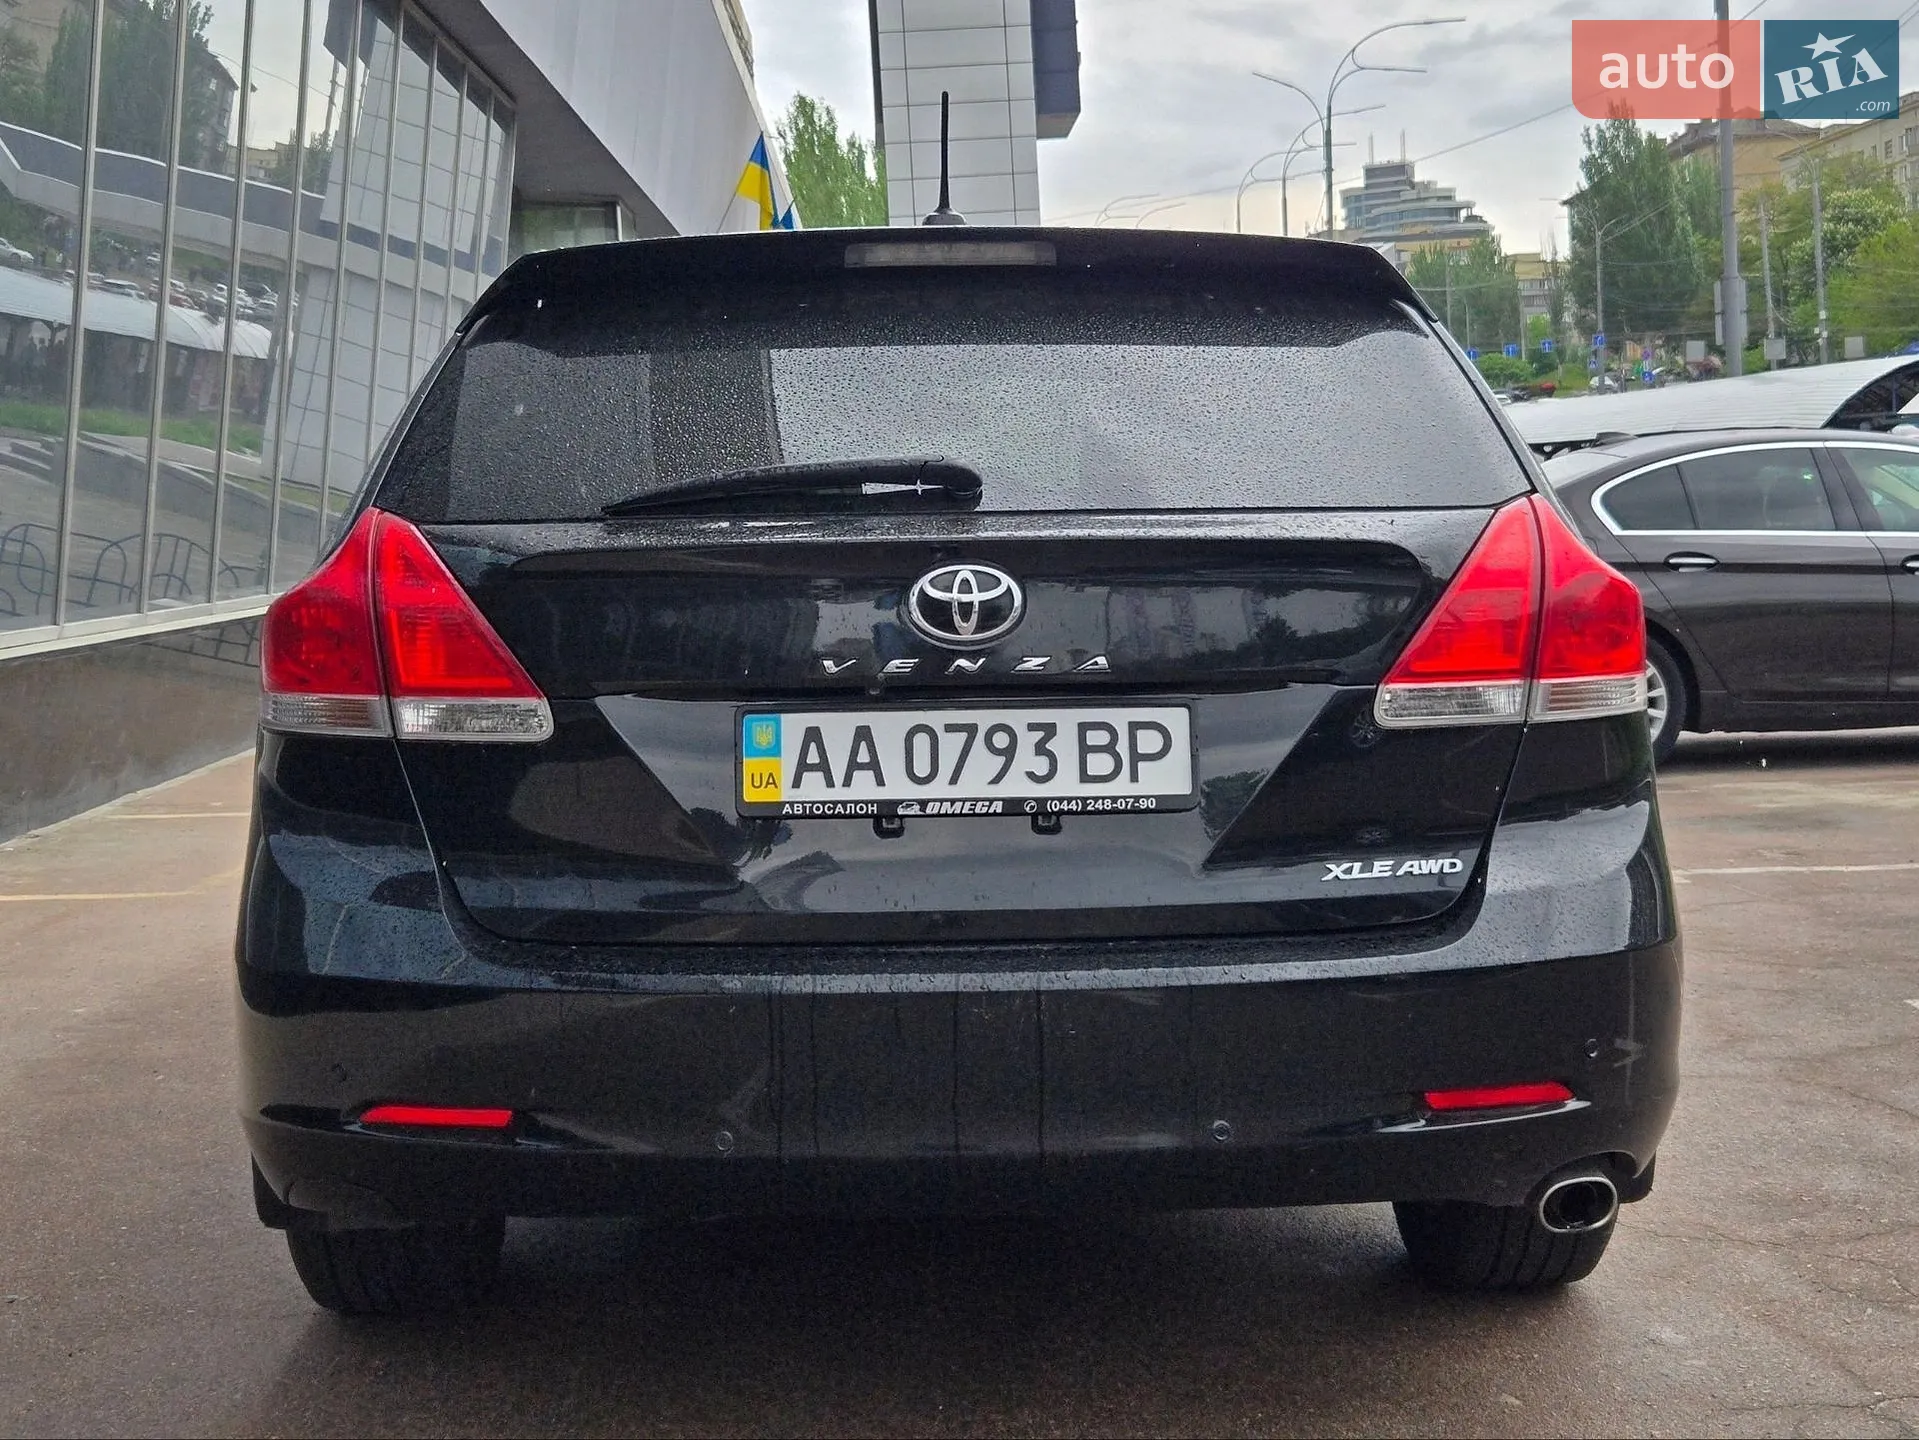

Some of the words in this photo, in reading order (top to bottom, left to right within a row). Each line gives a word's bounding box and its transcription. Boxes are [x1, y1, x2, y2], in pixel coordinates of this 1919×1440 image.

[822, 655, 1112, 675] VENZA
[791, 724, 886, 788] AA
[904, 722, 1058, 785] 0793
[1077, 720, 1173, 783] BP
[751, 772, 778, 789] UA
[782, 803, 878, 814] АВТОСАЛОН
[925, 800, 1003, 814] OMEGA
[1046, 799, 1083, 812] (044)
[1086, 797, 1156, 811] 248-07-90
[1320, 860, 1395, 881] XLE
[1395, 858, 1463, 876] AWD
